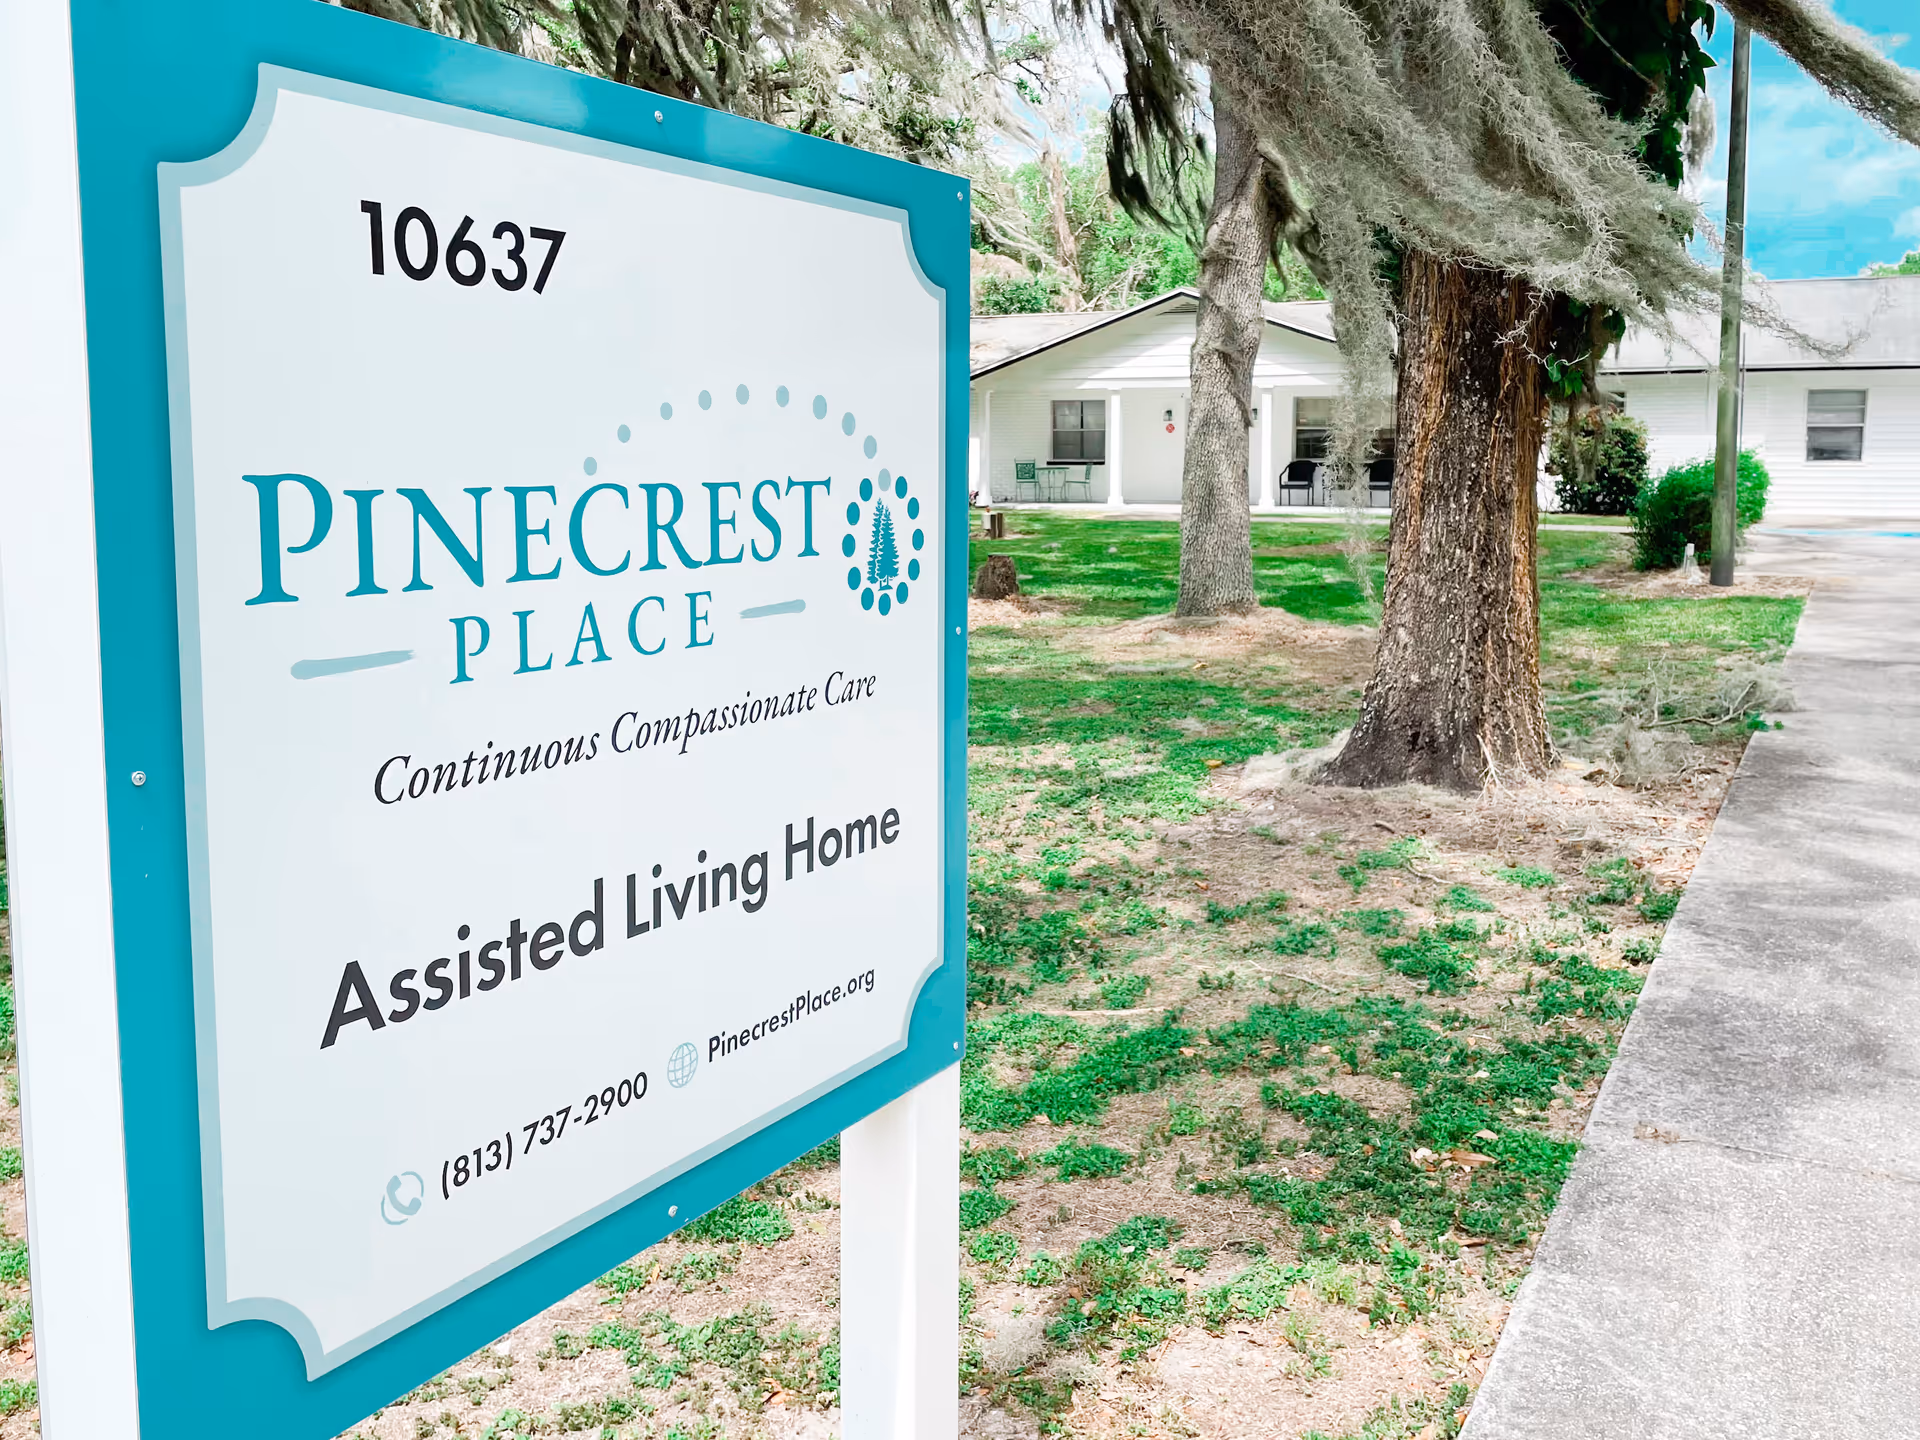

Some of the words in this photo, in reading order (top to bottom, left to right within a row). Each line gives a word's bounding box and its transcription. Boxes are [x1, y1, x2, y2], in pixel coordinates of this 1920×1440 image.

[360, 199, 567, 295] 10637
[241, 473, 832, 606] PINECREST
[448, 590, 714, 685] PLACE
[374, 732, 600, 805] Continuous
[611, 684, 818, 756] Compassionate
[824, 671, 876, 706] Care
[319, 877, 604, 1050] Assisted
[626, 849, 768, 939] Living
[785, 807, 900, 882] Home
[708, 969, 875, 1063] PinecrestPlace.org
[442, 1131, 513, 1201] (813)
[523, 1071, 648, 1155] 737-2900
